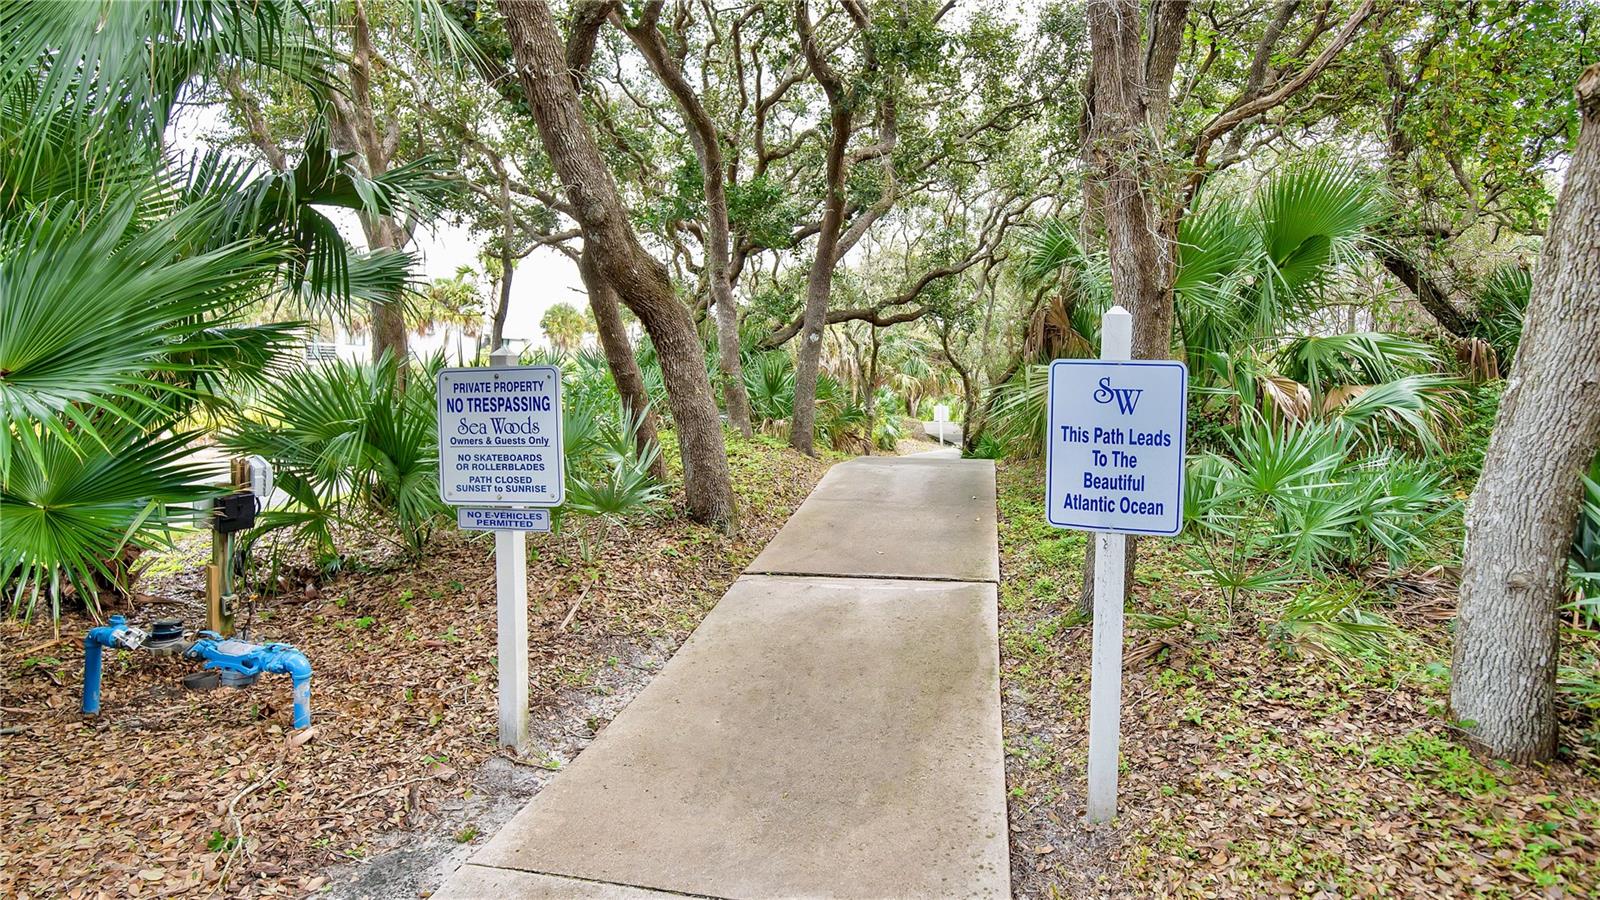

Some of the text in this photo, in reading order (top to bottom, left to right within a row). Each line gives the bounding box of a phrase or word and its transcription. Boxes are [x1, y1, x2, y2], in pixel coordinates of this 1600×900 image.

[453, 381, 544, 393] PRIVATE PROPERTY
[1094, 376, 1144, 415] SW
[447, 396, 550, 412] NO TRESPASSING
[458, 416, 540, 434] Sea Woods
[450, 437, 483, 445] Owners
[495, 437, 526, 445] Guests
[529, 437, 549, 446] Only
[1061, 426, 1171, 446] This Path Leads
[474, 454, 542, 462] SKATEBOARDS
[1092, 450, 1137, 468] To The
[506, 485, 547, 493] SUNRISE
[1084, 472, 1145, 491] Beautiful
[1064, 493, 1163, 515] Atlantic Ocean
[485, 512, 542, 520] E-VEHICLES
